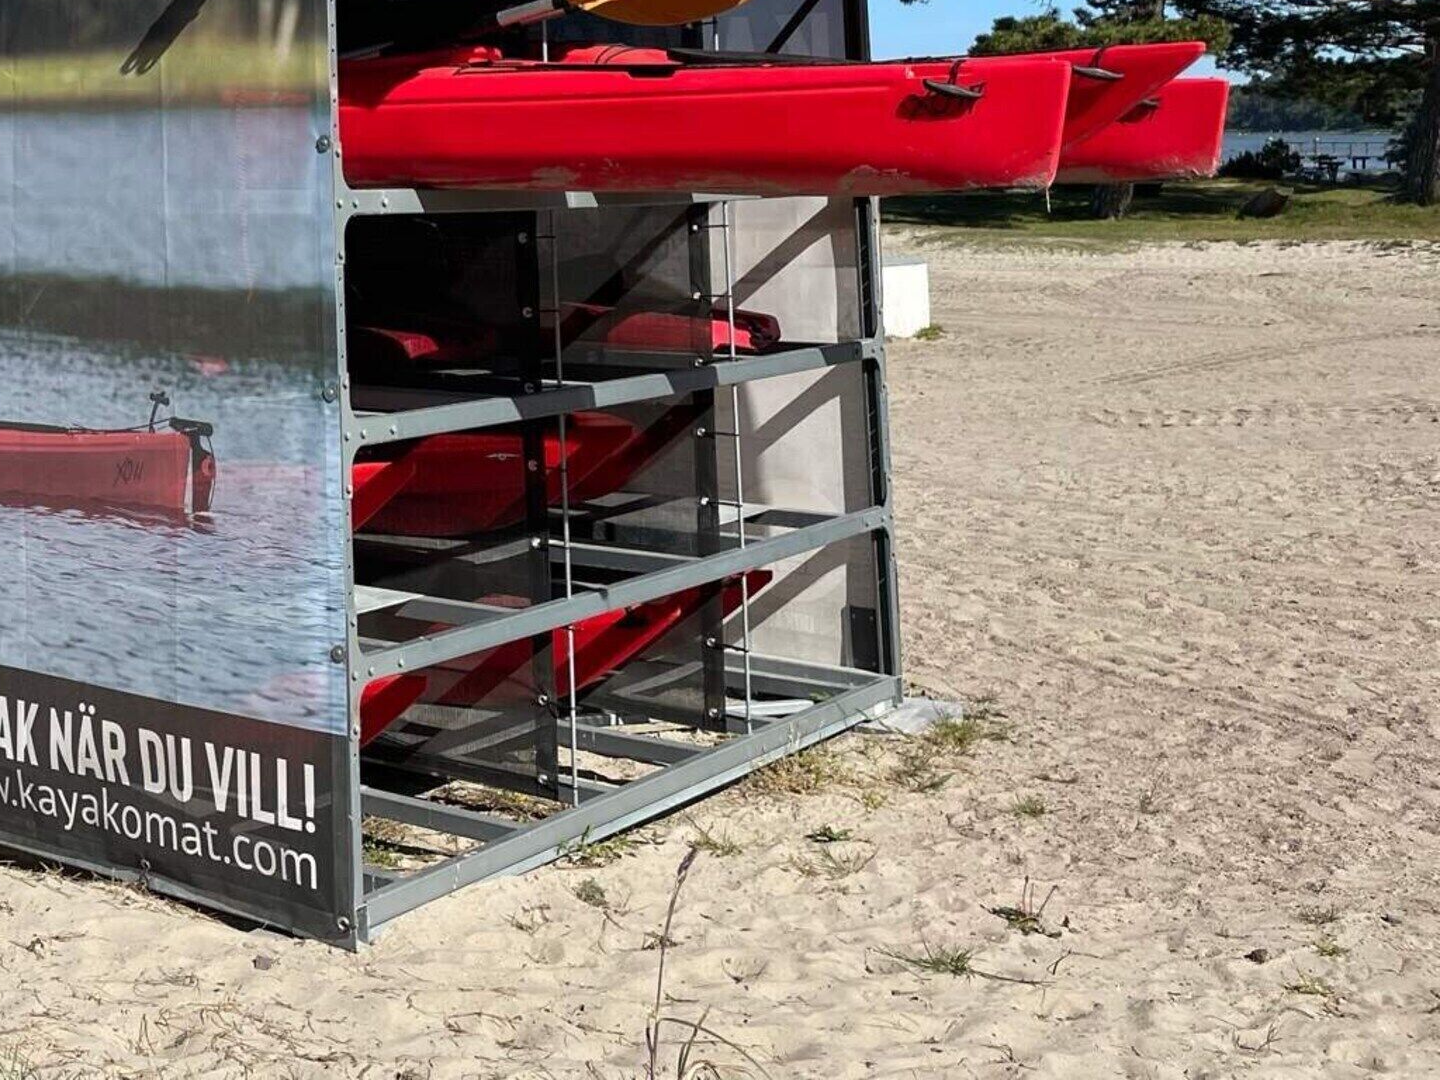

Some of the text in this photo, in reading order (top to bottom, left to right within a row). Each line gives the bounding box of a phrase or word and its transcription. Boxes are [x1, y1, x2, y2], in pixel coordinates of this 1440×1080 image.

[49, 702, 131, 787] NÄR
[138, 727, 194, 803] DU
[204, 741, 316, 834] VILL!
